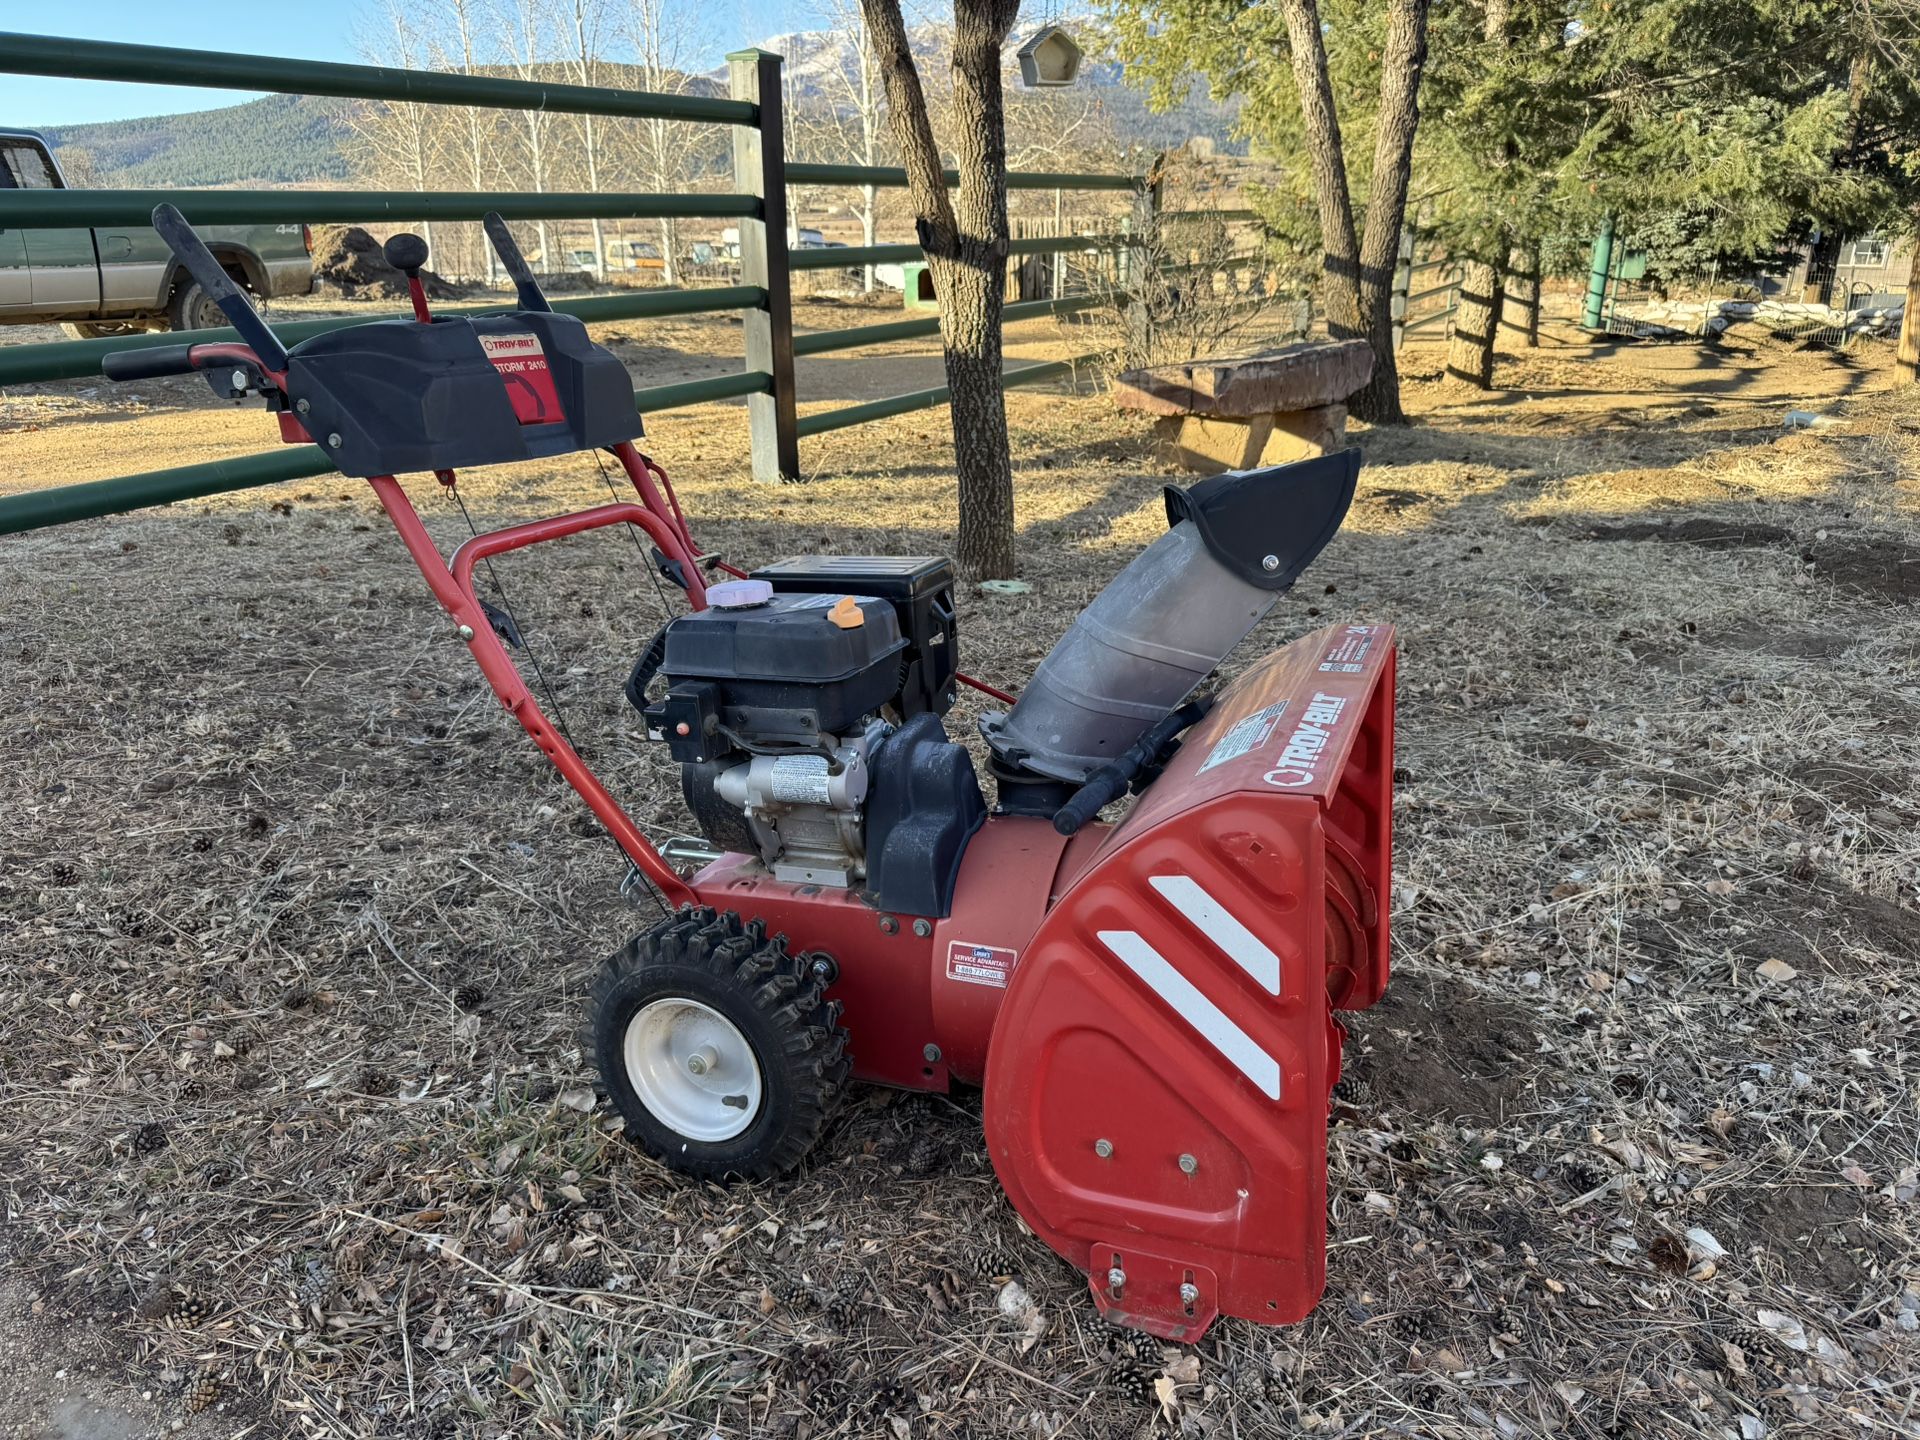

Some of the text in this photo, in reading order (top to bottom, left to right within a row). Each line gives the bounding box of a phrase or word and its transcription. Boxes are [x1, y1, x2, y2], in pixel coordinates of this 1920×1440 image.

[493, 339, 534, 350] TROY-BILT
[527, 361, 546, 371] 2410
[1276, 691, 1346, 769] TROY-BILT
[954, 954, 976, 963] SERVICE
